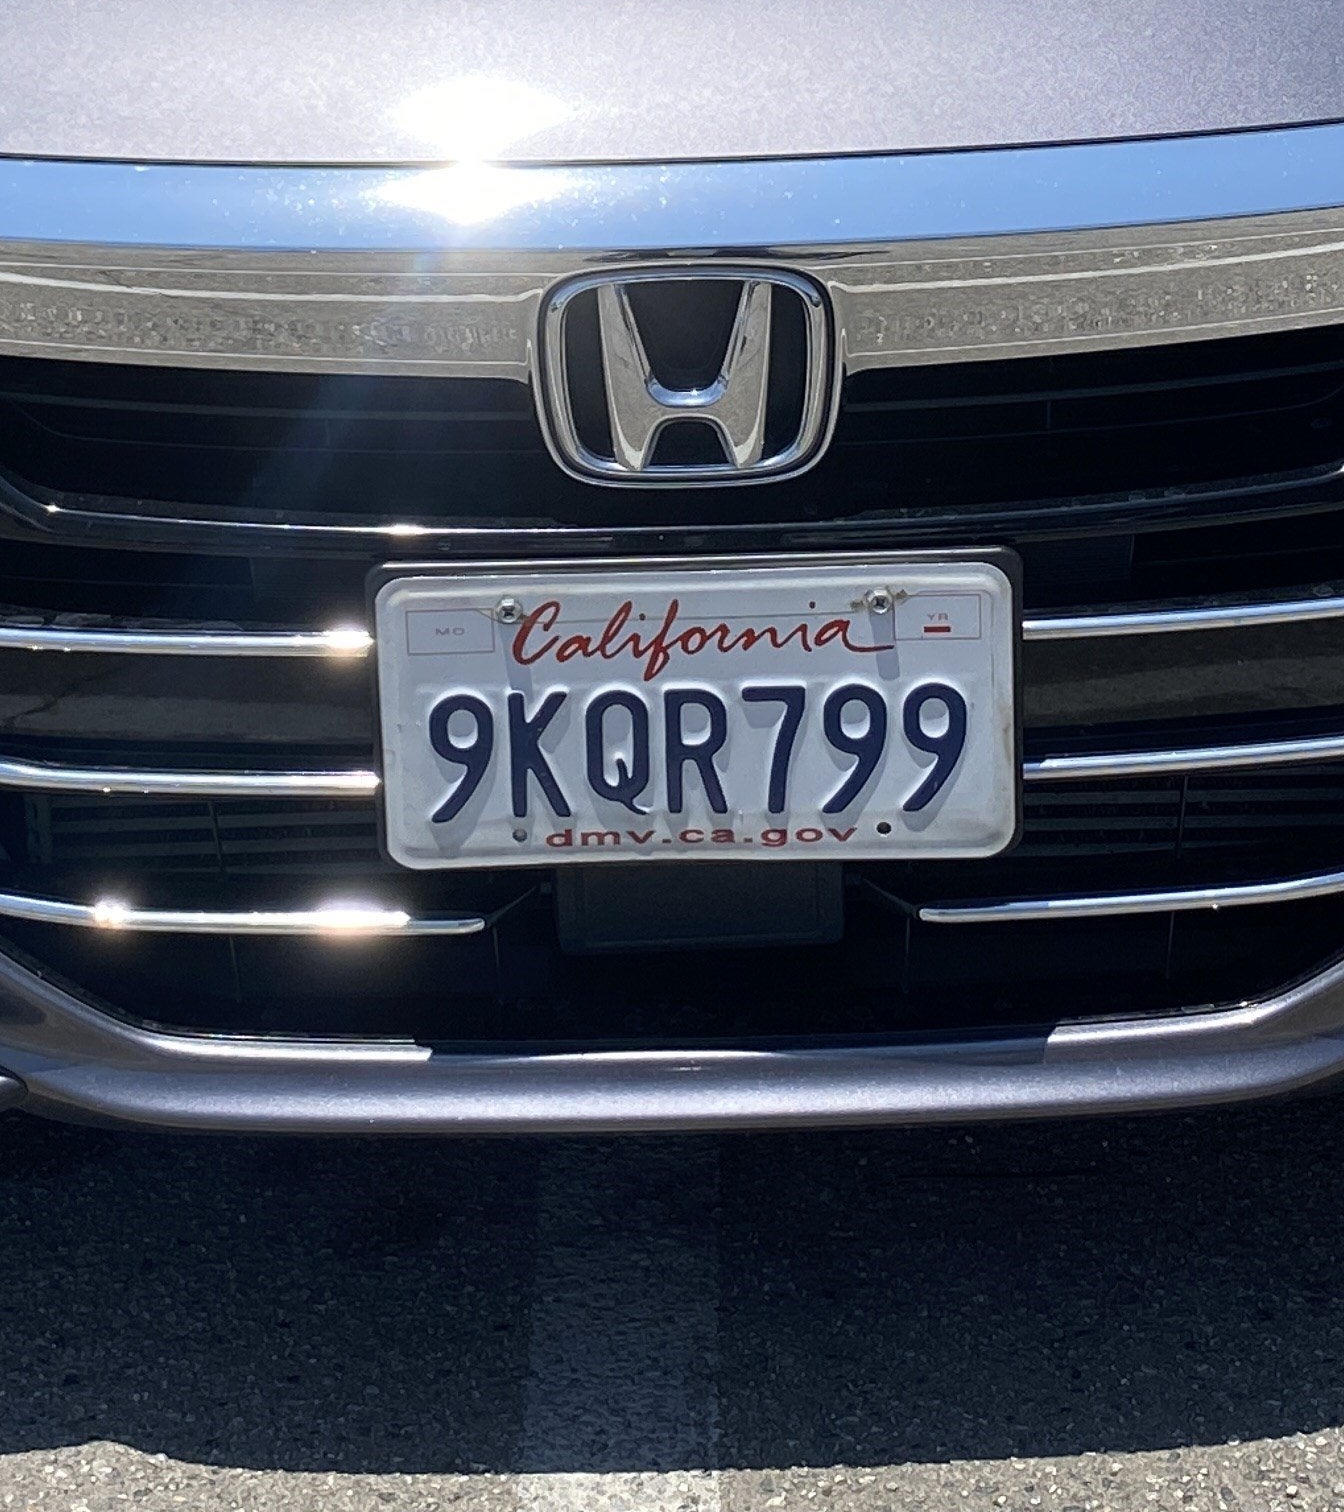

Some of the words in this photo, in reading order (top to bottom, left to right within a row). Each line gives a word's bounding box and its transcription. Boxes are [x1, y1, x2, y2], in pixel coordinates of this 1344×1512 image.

[435, 627, 465, 636] MO
[512, 598, 895, 682] California
[428, 682, 967, 824] 9KQR799
[545, 824, 859, 848] dmv.ca.gov
